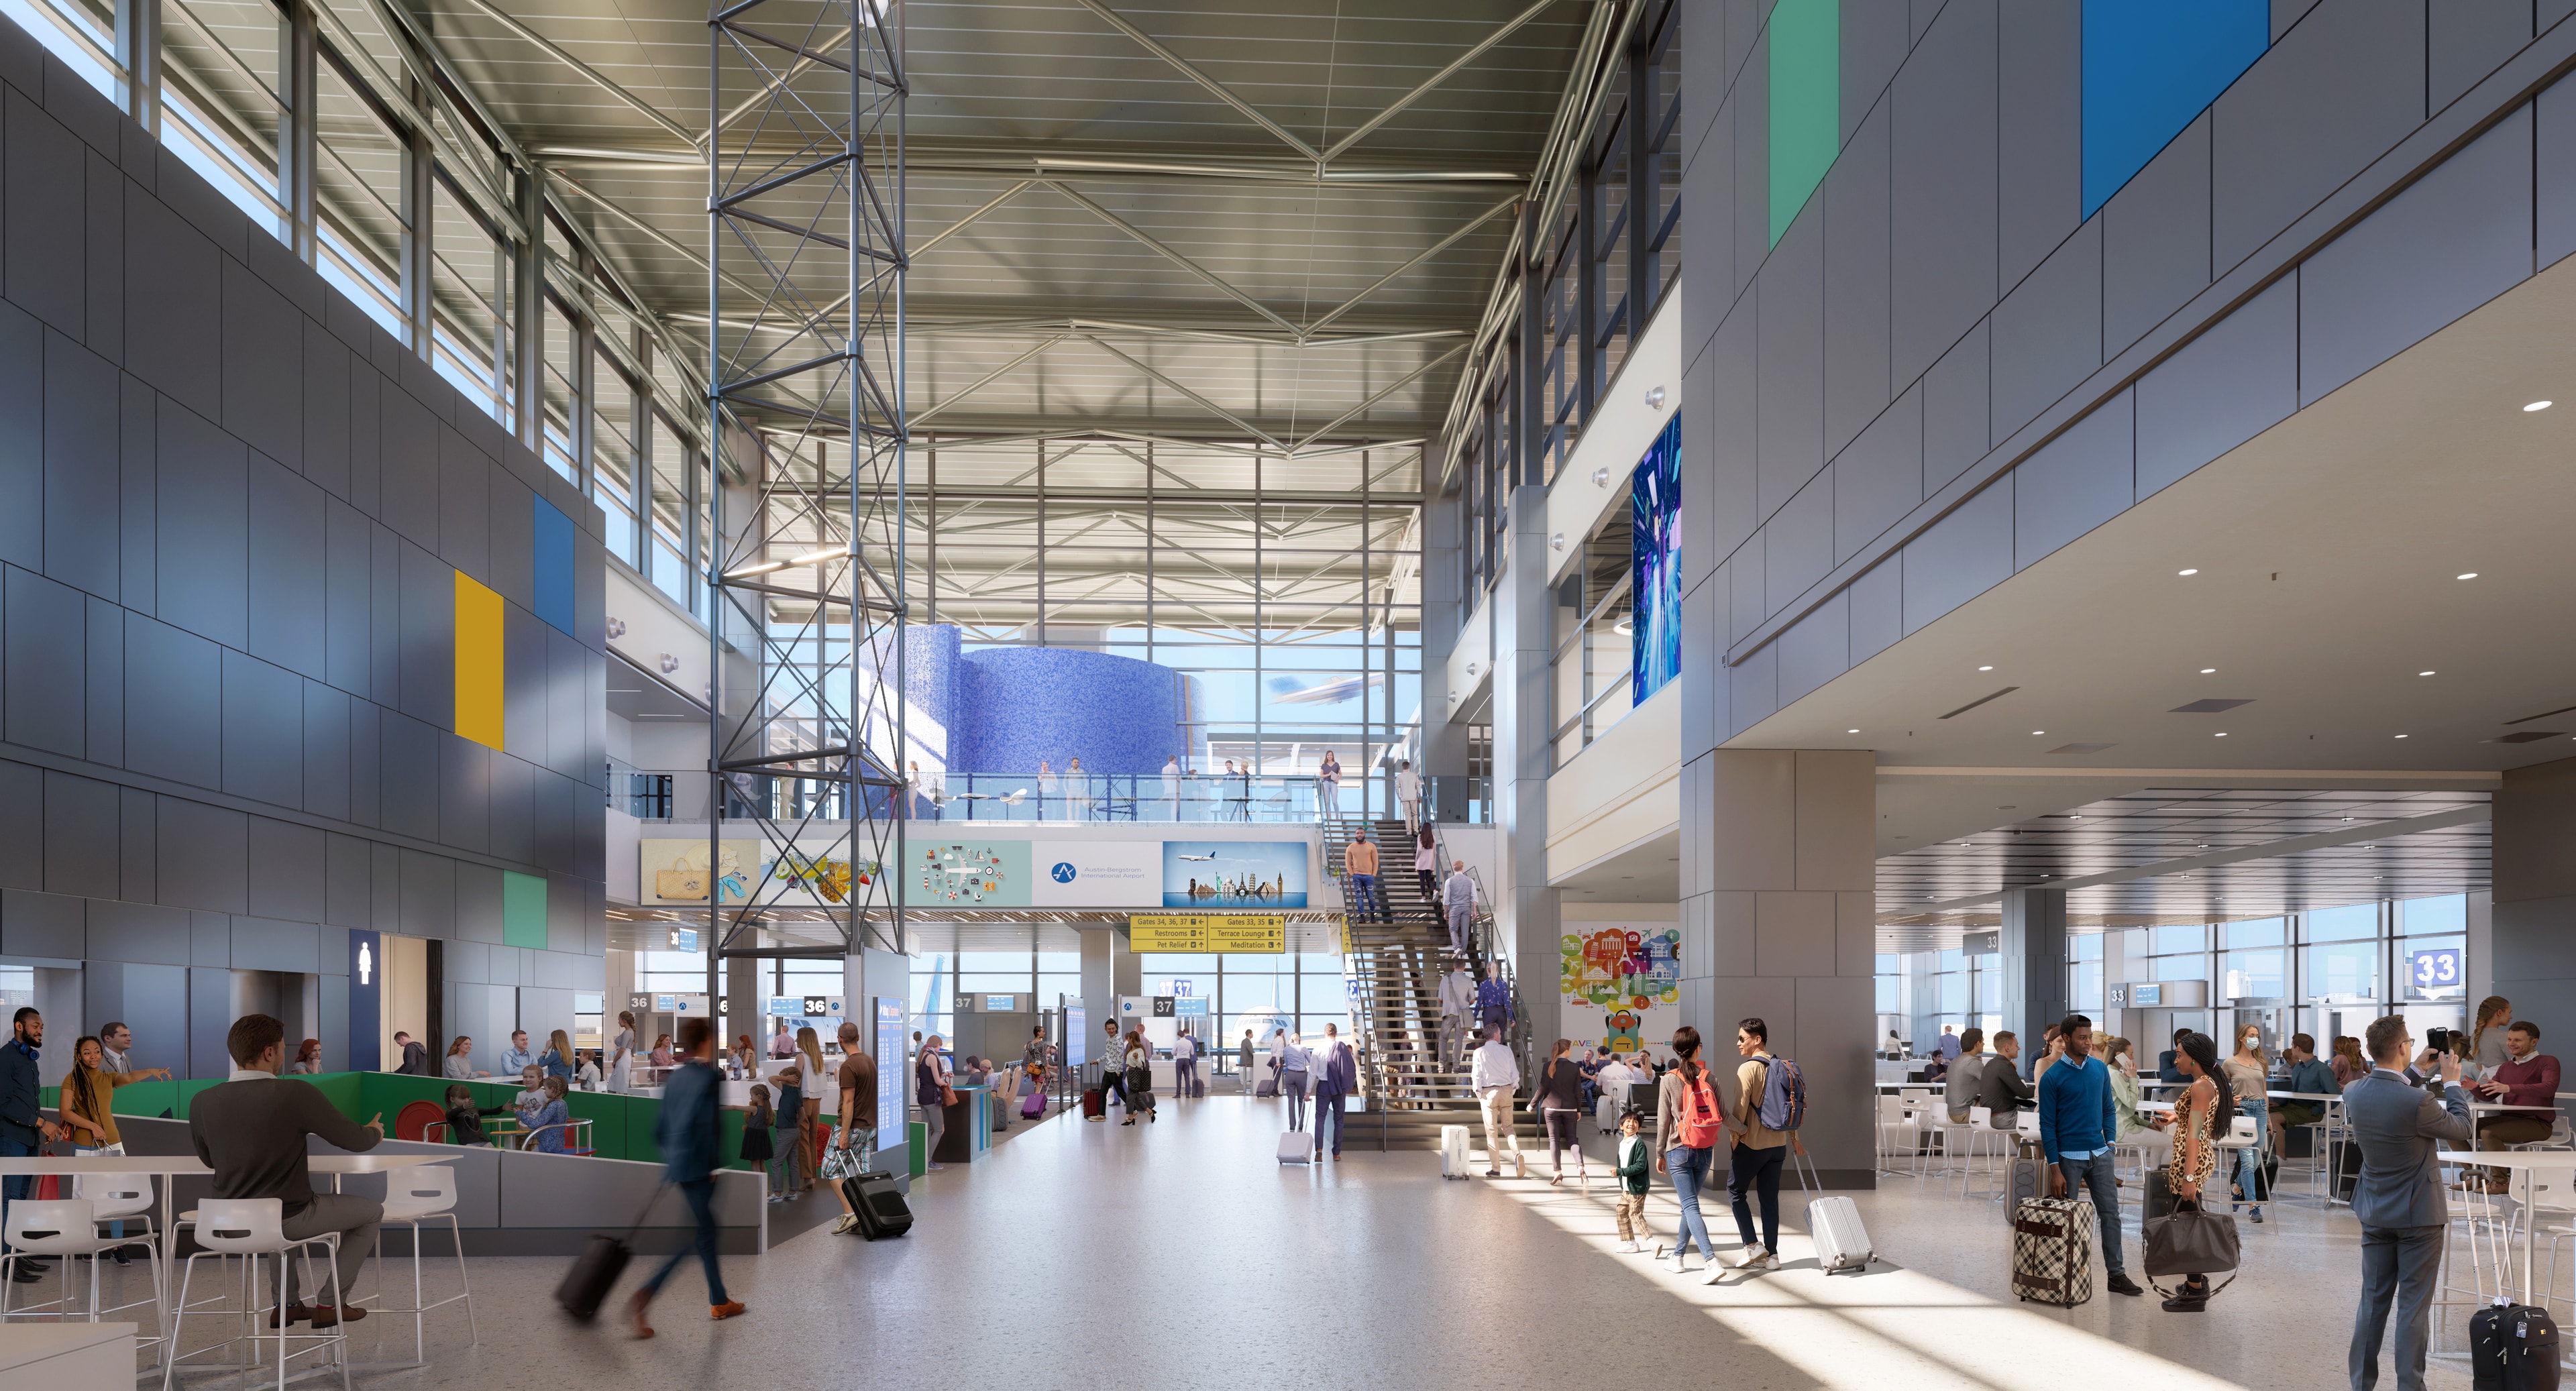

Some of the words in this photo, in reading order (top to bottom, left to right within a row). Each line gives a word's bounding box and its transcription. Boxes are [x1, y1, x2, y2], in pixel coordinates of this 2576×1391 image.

[671, 932, 679, 945] 36
[1242, 930, 1265, 938] Lounge
[1987, 936, 1997, 948] 33
[2416, 954, 2456, 982] 33
[1159, 981, 1173, 997] 37
[1175, 981, 1191, 997] 37
[2111, 989, 2125, 1002] 33
[631, 997, 647, 1008] 36
[718, 1000, 728, 1013] 6
[805, 1000, 825, 1013] 36
[955, 997, 971, 1008] 37
[1157, 1001, 1173, 1013] 37
